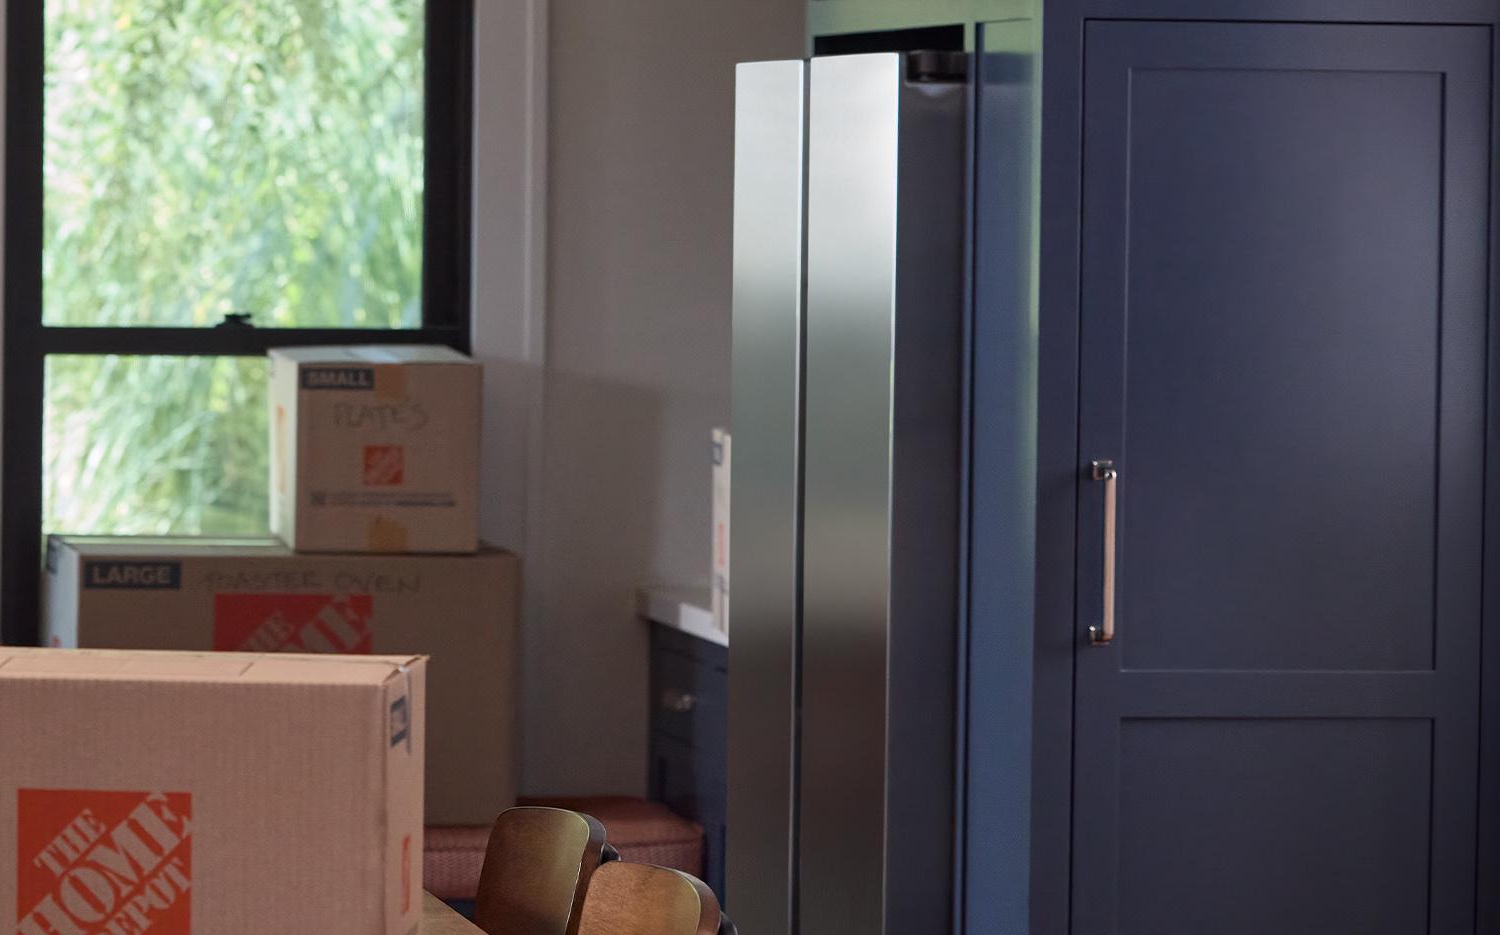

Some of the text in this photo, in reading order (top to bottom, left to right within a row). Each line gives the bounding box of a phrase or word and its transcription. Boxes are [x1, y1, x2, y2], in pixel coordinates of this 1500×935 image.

[306, 370, 368, 386] SMALL
[92, 564, 172, 585] LARGE
[17, 791, 192, 935] HOME
[32, 807, 107, 878] THE
[96, 857, 192, 935] EPOT
